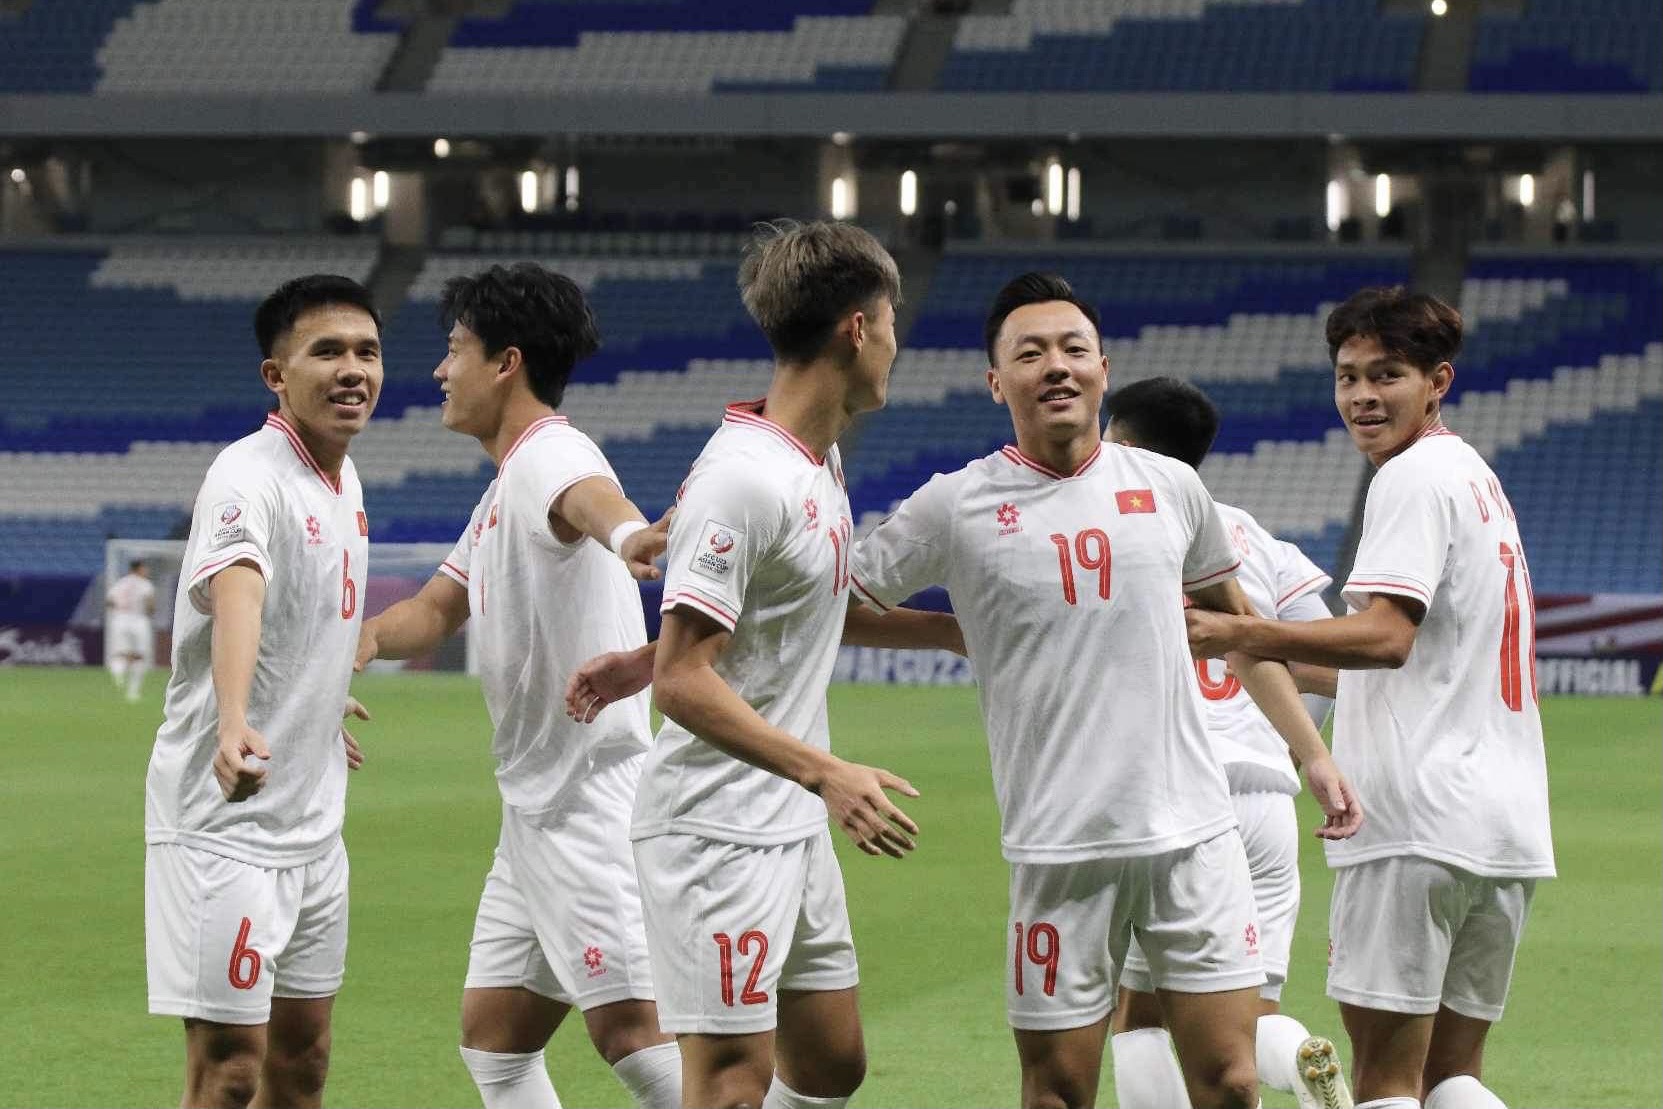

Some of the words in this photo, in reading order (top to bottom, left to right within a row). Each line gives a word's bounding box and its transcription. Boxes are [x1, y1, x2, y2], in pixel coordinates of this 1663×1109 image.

[341, 548, 356, 620] 6
[1050, 528, 1111, 605] 19
[228, 916, 261, 989] 6
[712, 930, 769, 1007] 12
[1014, 922, 1060, 997] 19
